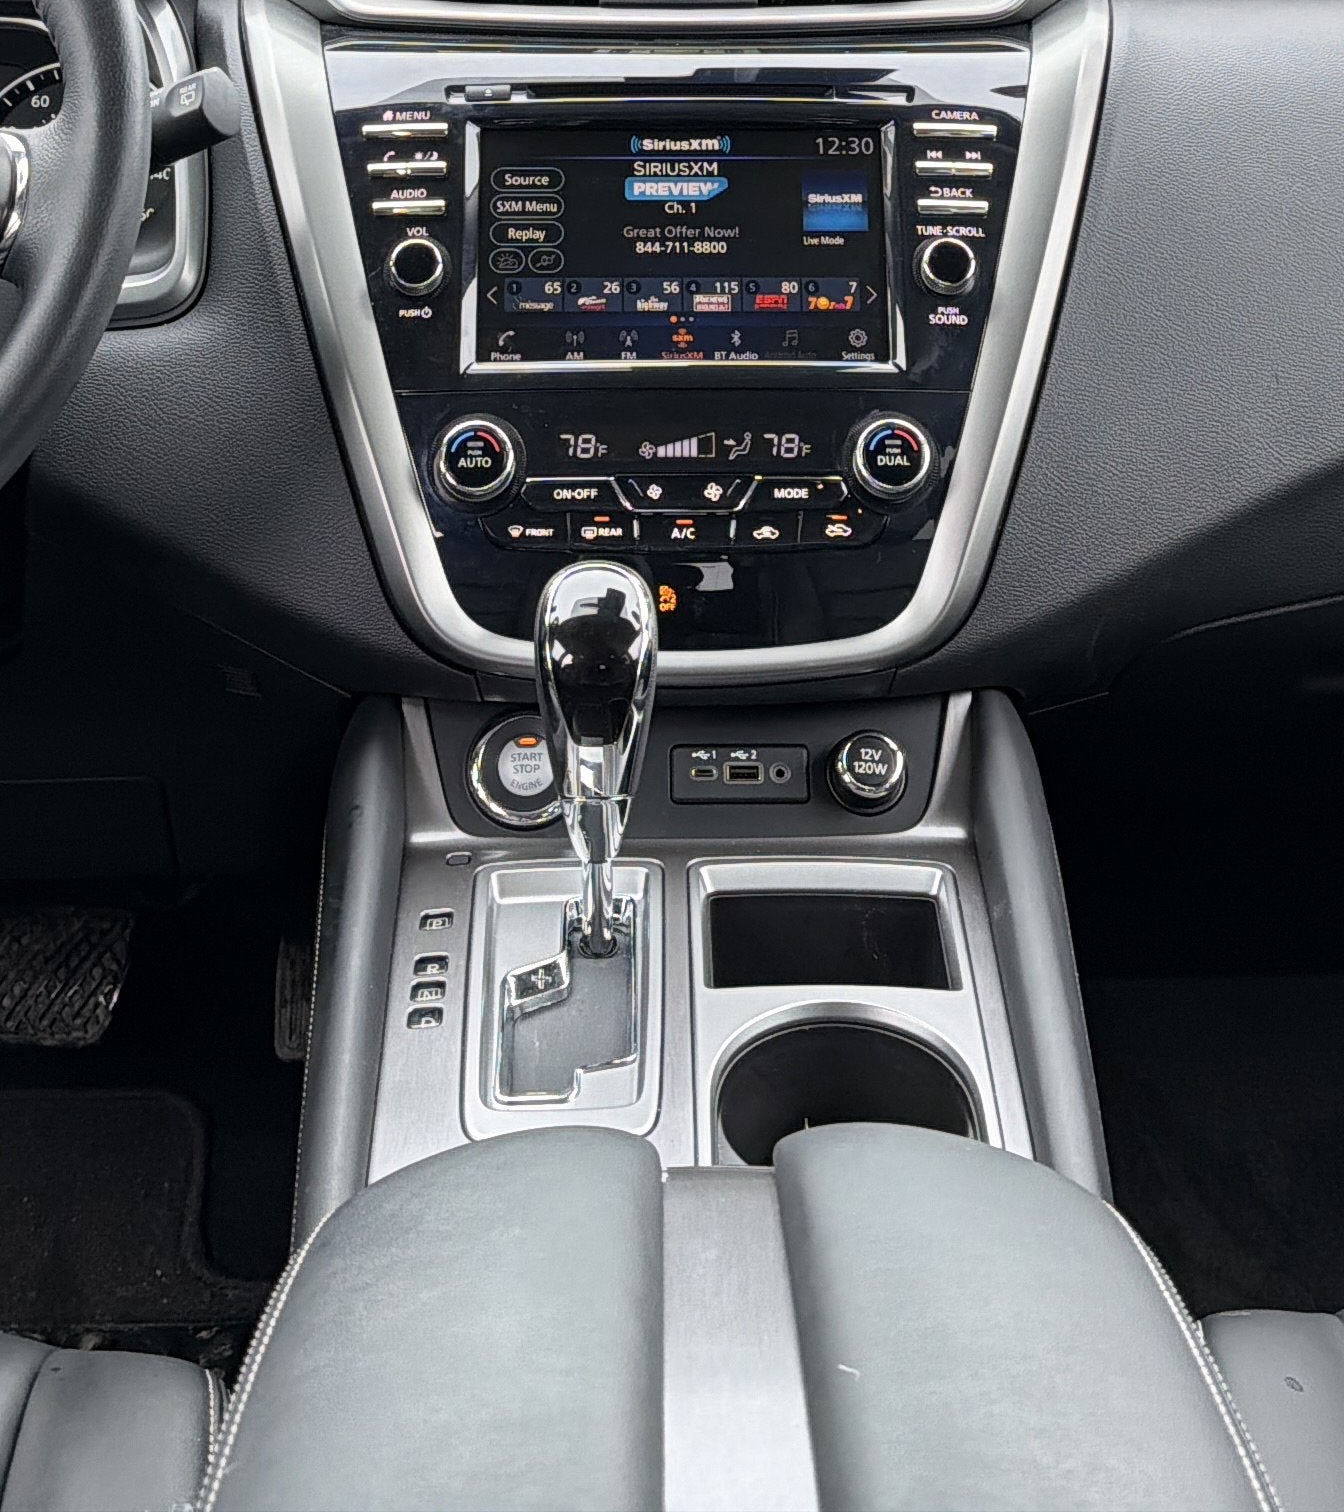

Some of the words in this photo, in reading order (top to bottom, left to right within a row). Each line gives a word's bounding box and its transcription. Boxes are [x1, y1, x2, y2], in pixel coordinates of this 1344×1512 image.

[31, 96, 49, 108] 60
[396, 111, 430, 121] MENU
[931, 110, 979, 121] CAMERA
[816, 137, 874, 155] 12:30
[633, 161, 718, 176] SIRIUSXM
[504, 174, 549, 185] Source
[390, 189, 427, 199] AUDIO
[633, 182, 719, 196] PREVIEW
[944, 188, 973, 198] BACK
[496, 201, 522, 212] SXM
[525, 201, 558, 212] Menu
[664, 202, 686, 214] Ch.
[690, 202, 696, 213] 1
[406, 227, 429, 236] VOL
[508, 228, 546, 242] Replay
[623, 226, 661, 238] Great
[664, 226, 701, 238] Offer
[705, 226, 739, 237] Now!
[803, 236, 819, 245] Live
[821, 236, 844, 245] Mode
[635, 242, 727, 254] 844-711-8800
[544, 282, 561, 293] 65
[603, 282, 620, 294] 26
[663, 282, 680, 293] 56
[714, 282, 739, 294] 115
[781, 282, 798, 294] 80
[849, 282, 857, 293] 7
[637, 299, 668, 311] highway
[756, 295, 788, 304] ESPN
[399, 309, 421, 317] PUSH
[928, 314, 968, 325] SOUND
[490, 352, 522, 361] Phone
[566, 352, 584, 360] AM
[621, 352, 637, 360] FM
[714, 352, 728, 360] BT
[730, 352, 758, 360] Audio
[842, 351, 875, 361] Settings
[458, 457, 491, 468] AUTO
[876, 455, 911, 466] DUAL
[774, 488, 808, 499] MODE
[526, 528, 554, 537] FRONT
[599, 527, 622, 536] REAR
[670, 527, 695, 539] A/C
[510, 752, 544, 763] START
[750, 750, 756, 760] 2
[860, 748, 882, 761] 12V
[513, 764, 541, 774] STOP
[853, 762, 888, 775] 120W
[510, 778, 543, 791] ENGINE
